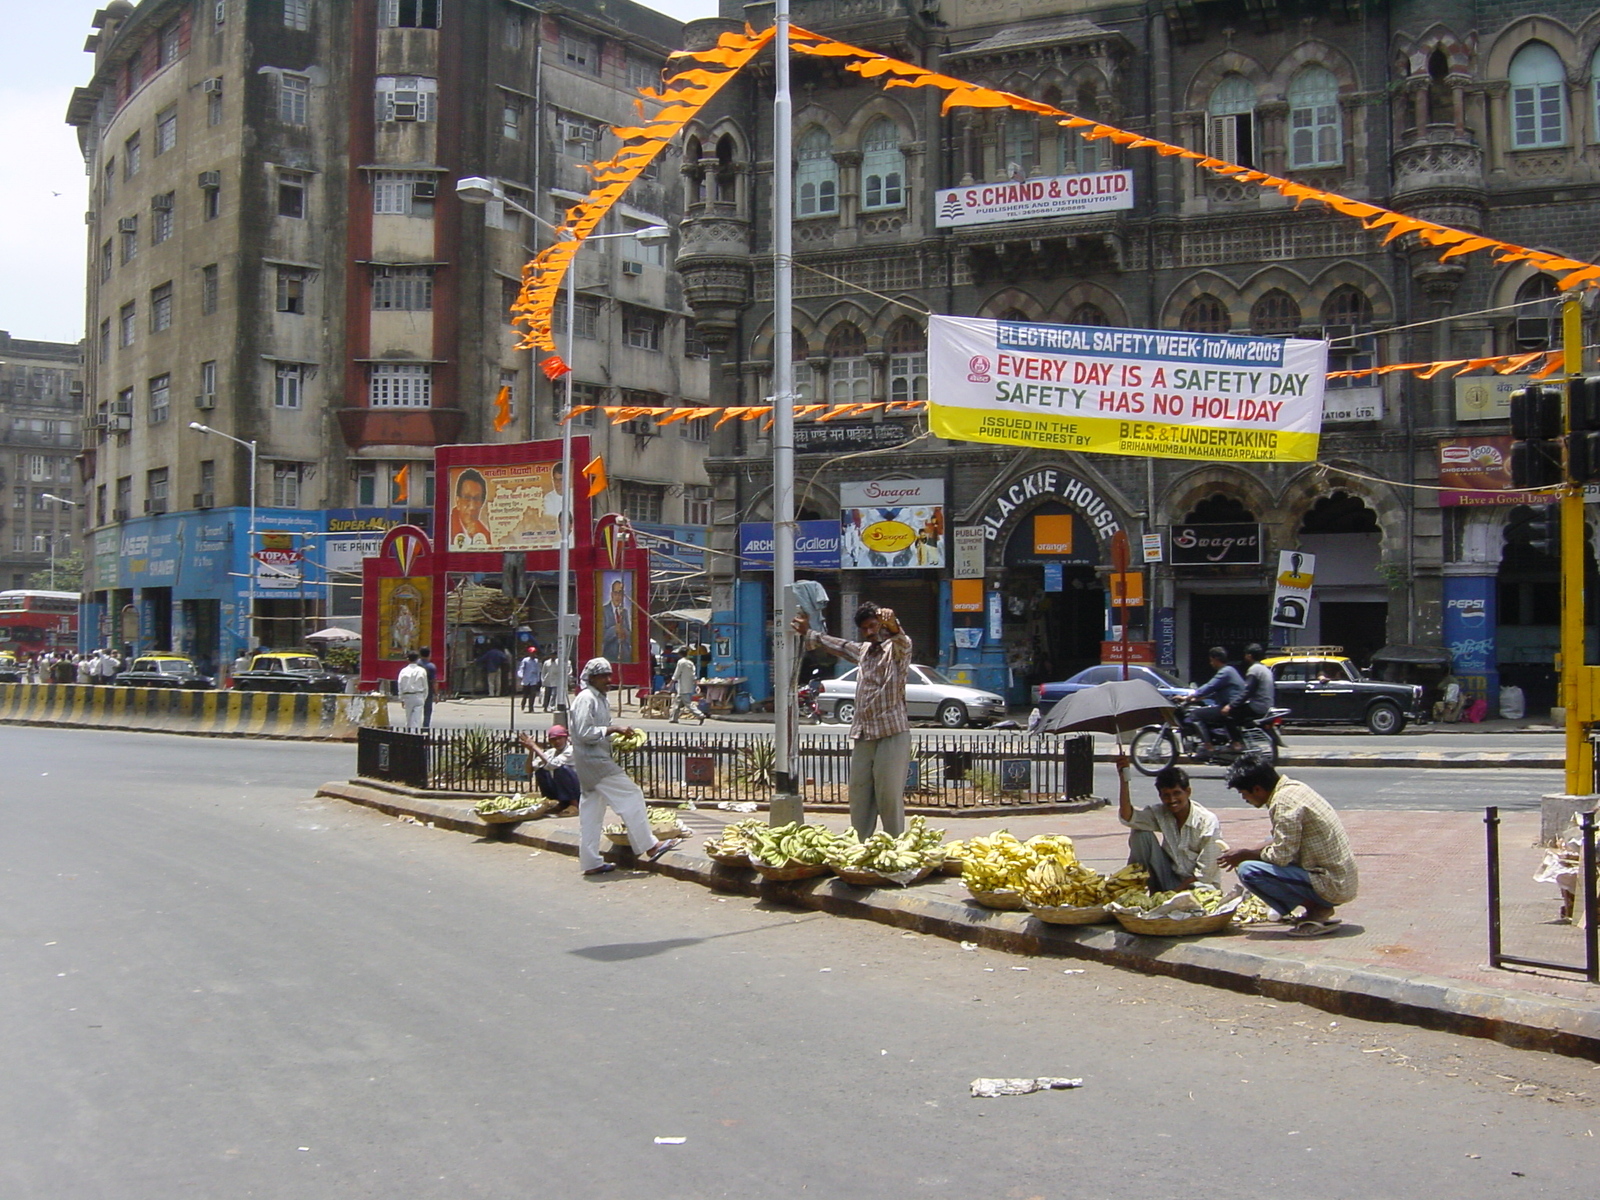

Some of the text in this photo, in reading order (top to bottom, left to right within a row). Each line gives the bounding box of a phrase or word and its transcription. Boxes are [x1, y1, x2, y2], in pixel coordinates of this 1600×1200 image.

[1048, 180, 1061, 198] &
[976, 203, 1030, 214] PUBLISHERS
[1052, 195, 1118, 206] DISTRIBUTORS
[1000, 325, 1090, 350] ELECTRICAL
[1093, 332, 1154, 354] SAFETY
[997, 354, 1309, 396] EVERY DAY IS A SAFETY DAY
[995, 381, 1283, 422] SAFETY HAS NO HOLIDAY
[1356, 409, 1374, 417] LTD.
[983, 416, 1078, 434] ISSUED IN THE
[979, 426, 1091, 446] PUBLIC INTEREST BY
[1471, 446, 1491, 459] GOOD
[984, 470, 1119, 541] BLACKIE HOUSE
[1460, 496, 1487, 505] Have
[1496, 494, 1524, 504] Good
[1528, 494, 1548, 505] Day
[868, 527, 908, 546] Swagat
[955, 528, 983, 537] PUBLIC
[120, 530, 149, 557] LASER
[333, 543, 347, 552] THE
[795, 536, 839, 552] Gallery
[1036, 544, 1067, 552] orange
[1174, 529, 1257, 561] Swagat
[258, 551, 298, 560] TOPAZ
[1113, 598, 1140, 606] ornge
[1447, 600, 1485, 609] PEPSI
[237, 601, 246, 636] LASER
[1161, 616, 1174, 665] EXCALIBUR
[1456, 676, 1487, 690] STD
